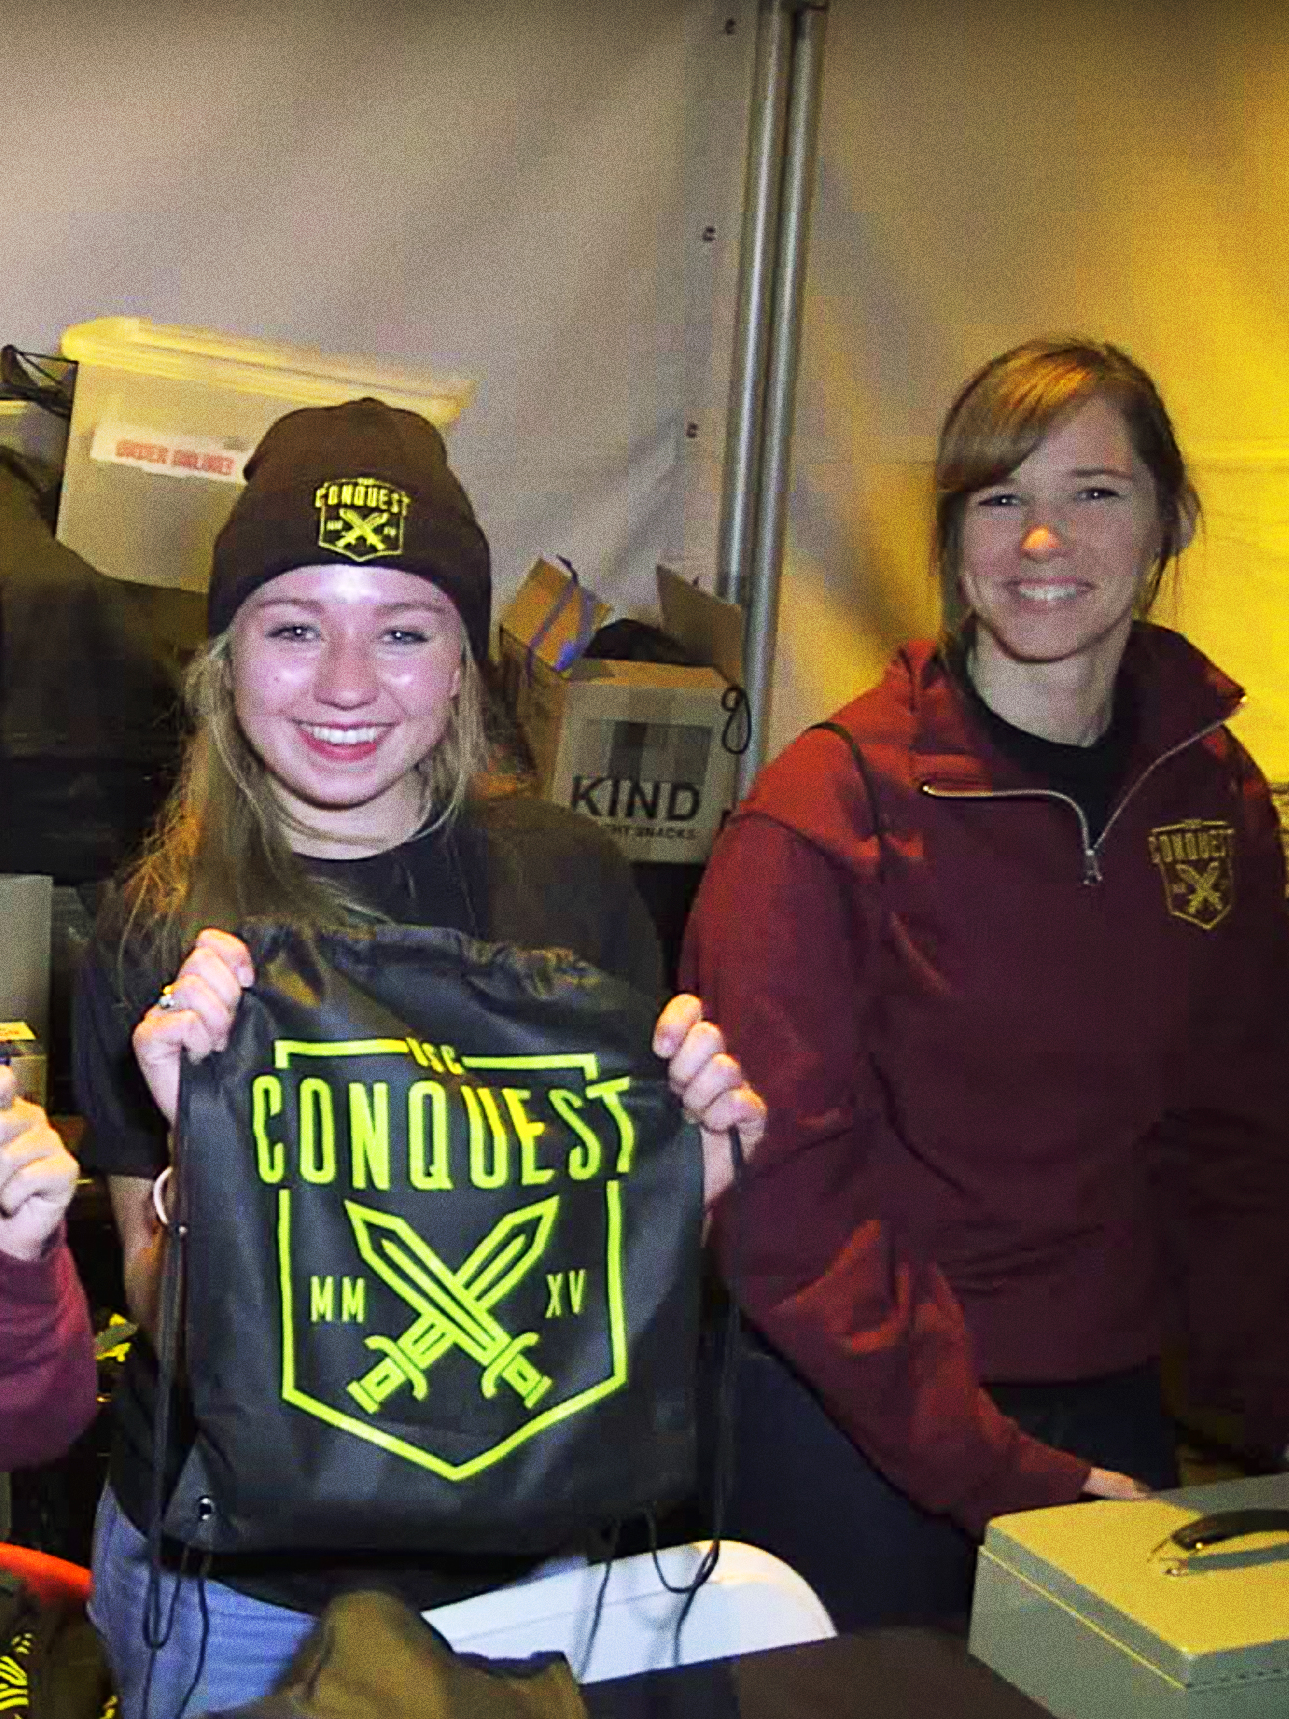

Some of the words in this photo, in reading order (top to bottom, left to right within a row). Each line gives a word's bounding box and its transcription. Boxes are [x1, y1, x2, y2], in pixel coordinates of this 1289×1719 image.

[314, 484, 411, 517] CONQUEST
[570, 774, 701, 822] KIND
[252, 1074, 634, 1191] CONQUEST
[310, 1275, 366, 1324] MM
[544, 1269, 587, 1319] XV
